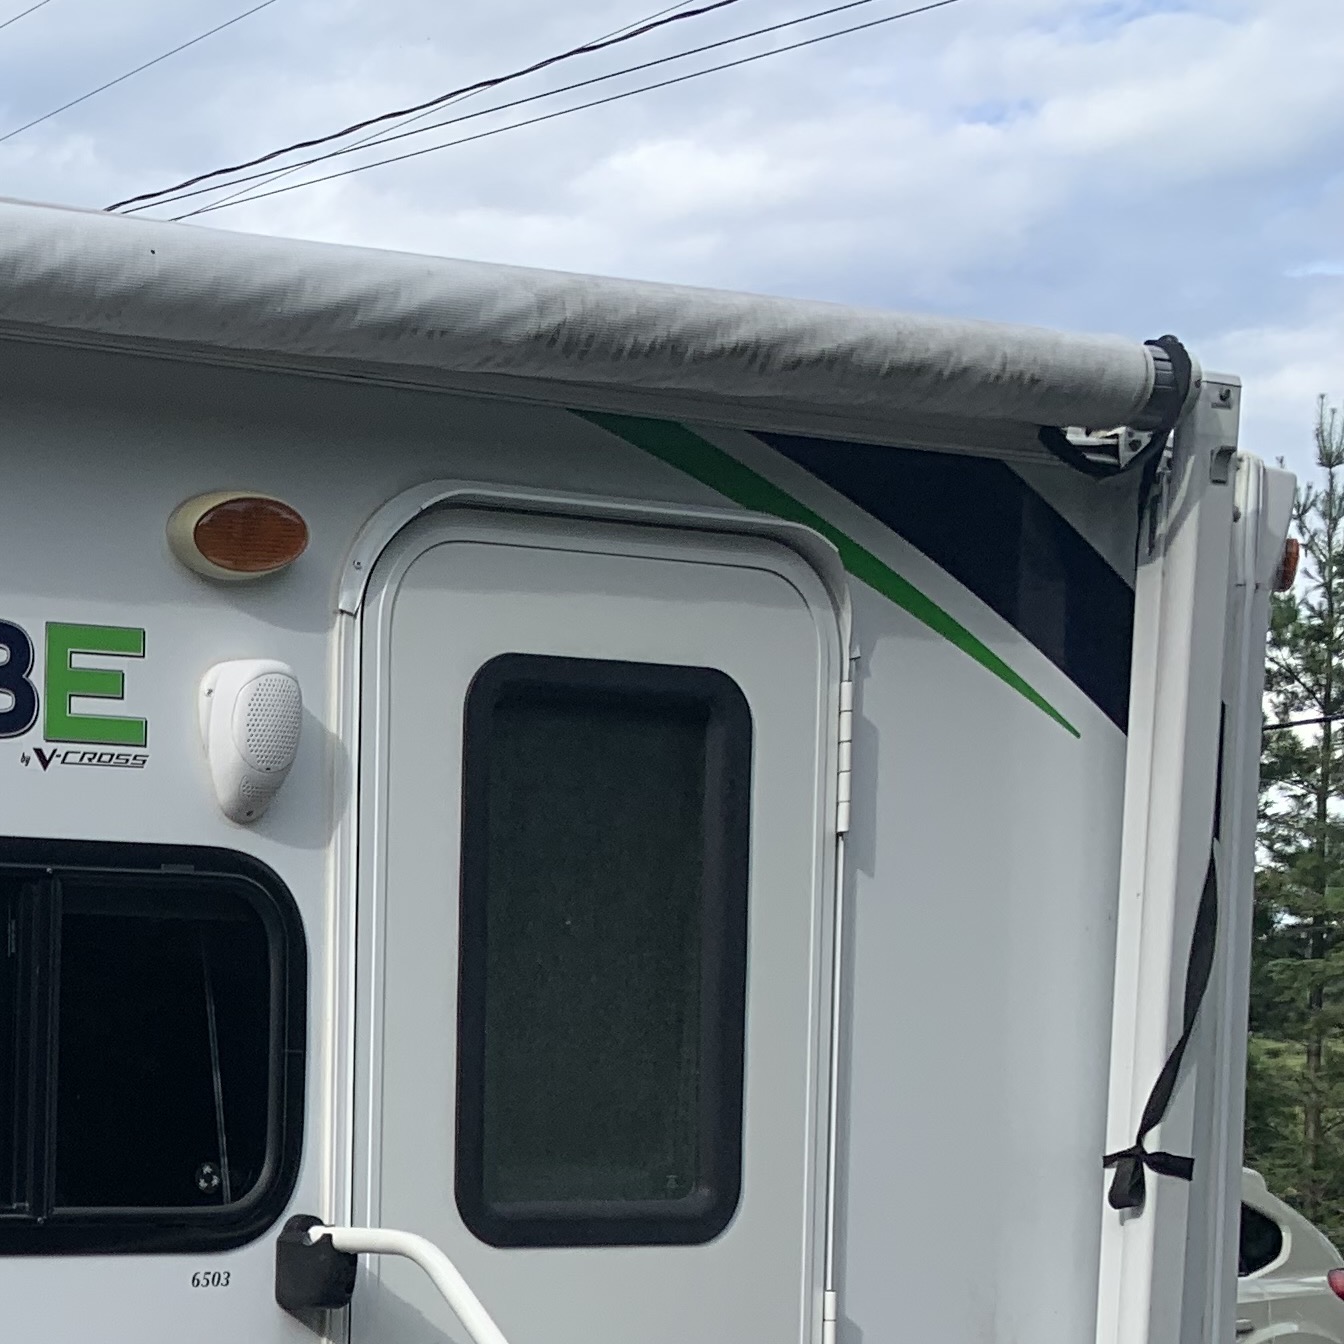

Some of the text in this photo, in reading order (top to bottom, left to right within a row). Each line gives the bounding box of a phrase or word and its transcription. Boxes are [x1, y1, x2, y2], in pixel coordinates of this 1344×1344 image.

[20, 746, 150, 772] by V-CROSS
[191, 1270, 231, 1288] 6503
